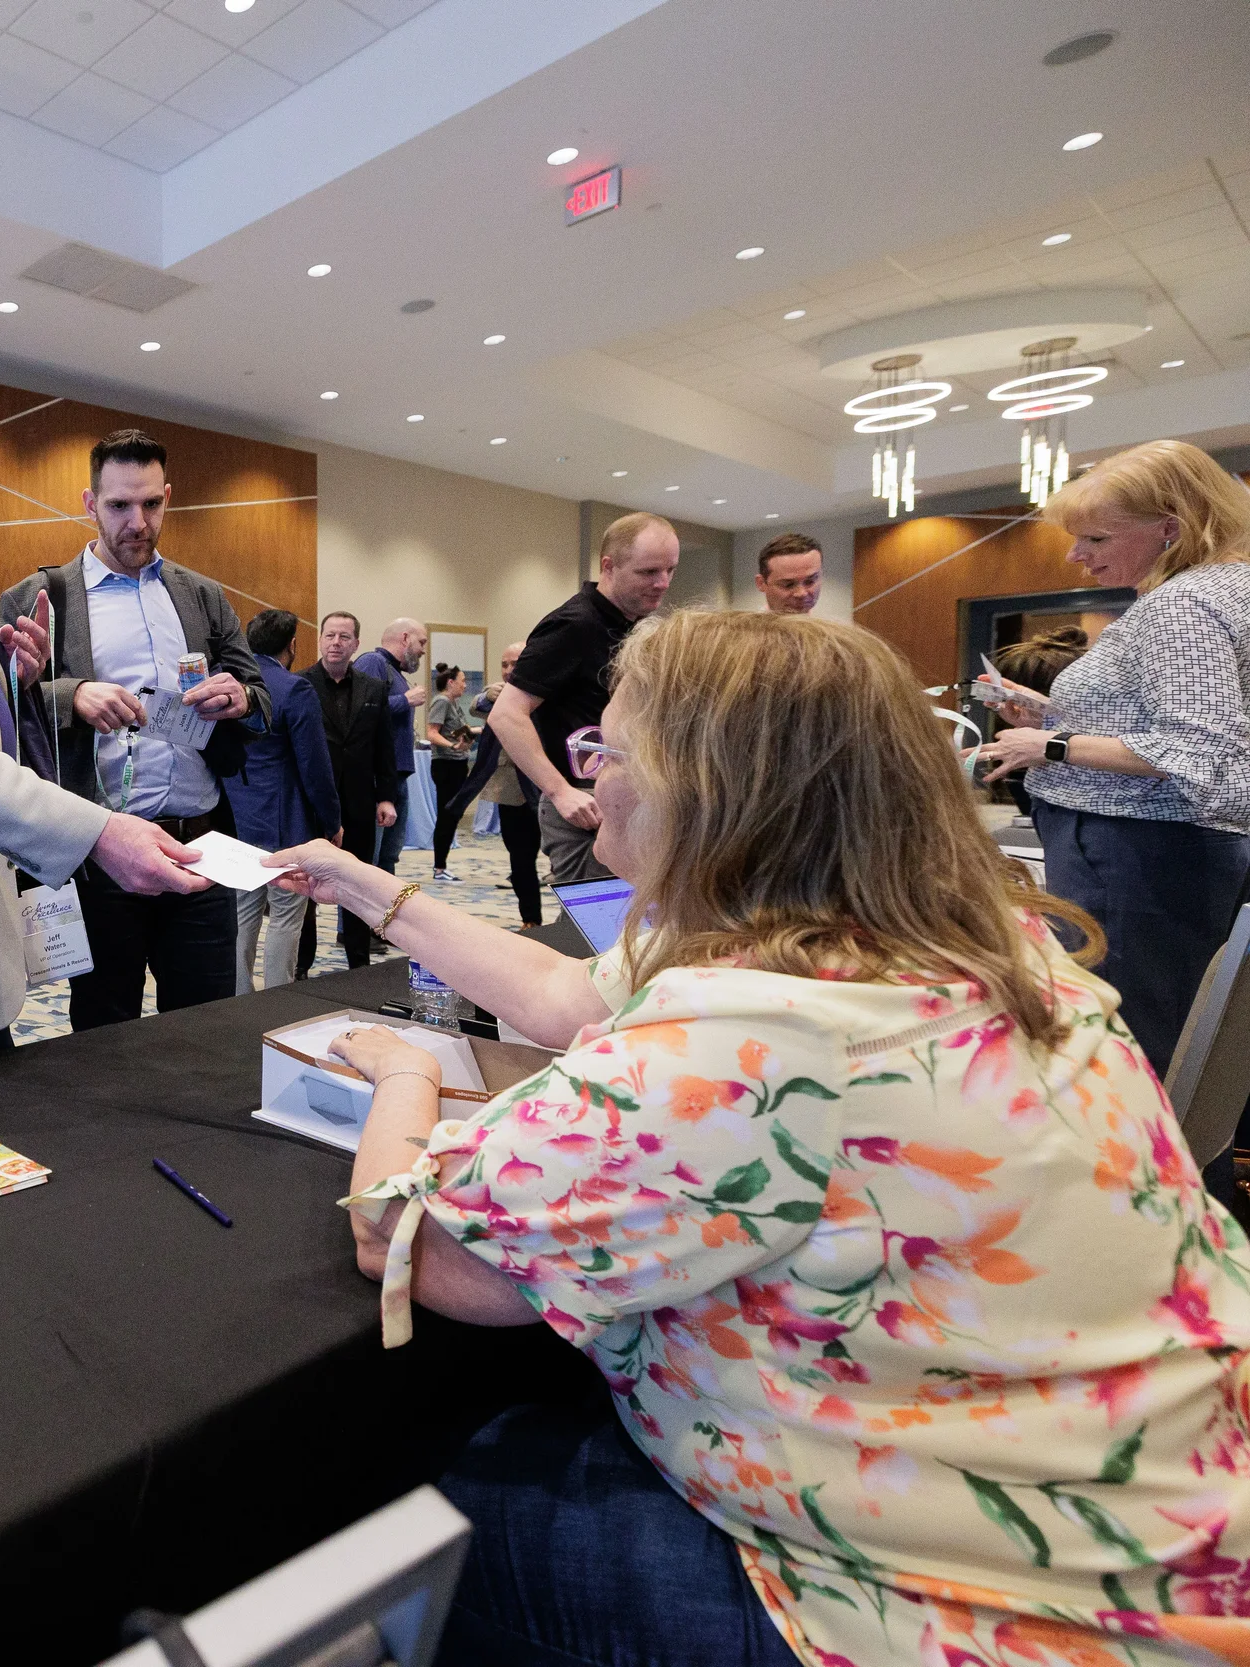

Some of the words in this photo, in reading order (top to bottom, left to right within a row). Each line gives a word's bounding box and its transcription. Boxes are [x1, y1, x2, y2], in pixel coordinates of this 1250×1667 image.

[573, 172, 612, 216] EXIT
[31, 904, 73, 921] Excellence
[47, 933, 60, 943] Jeff
[44, 942, 67, 952] Waters
